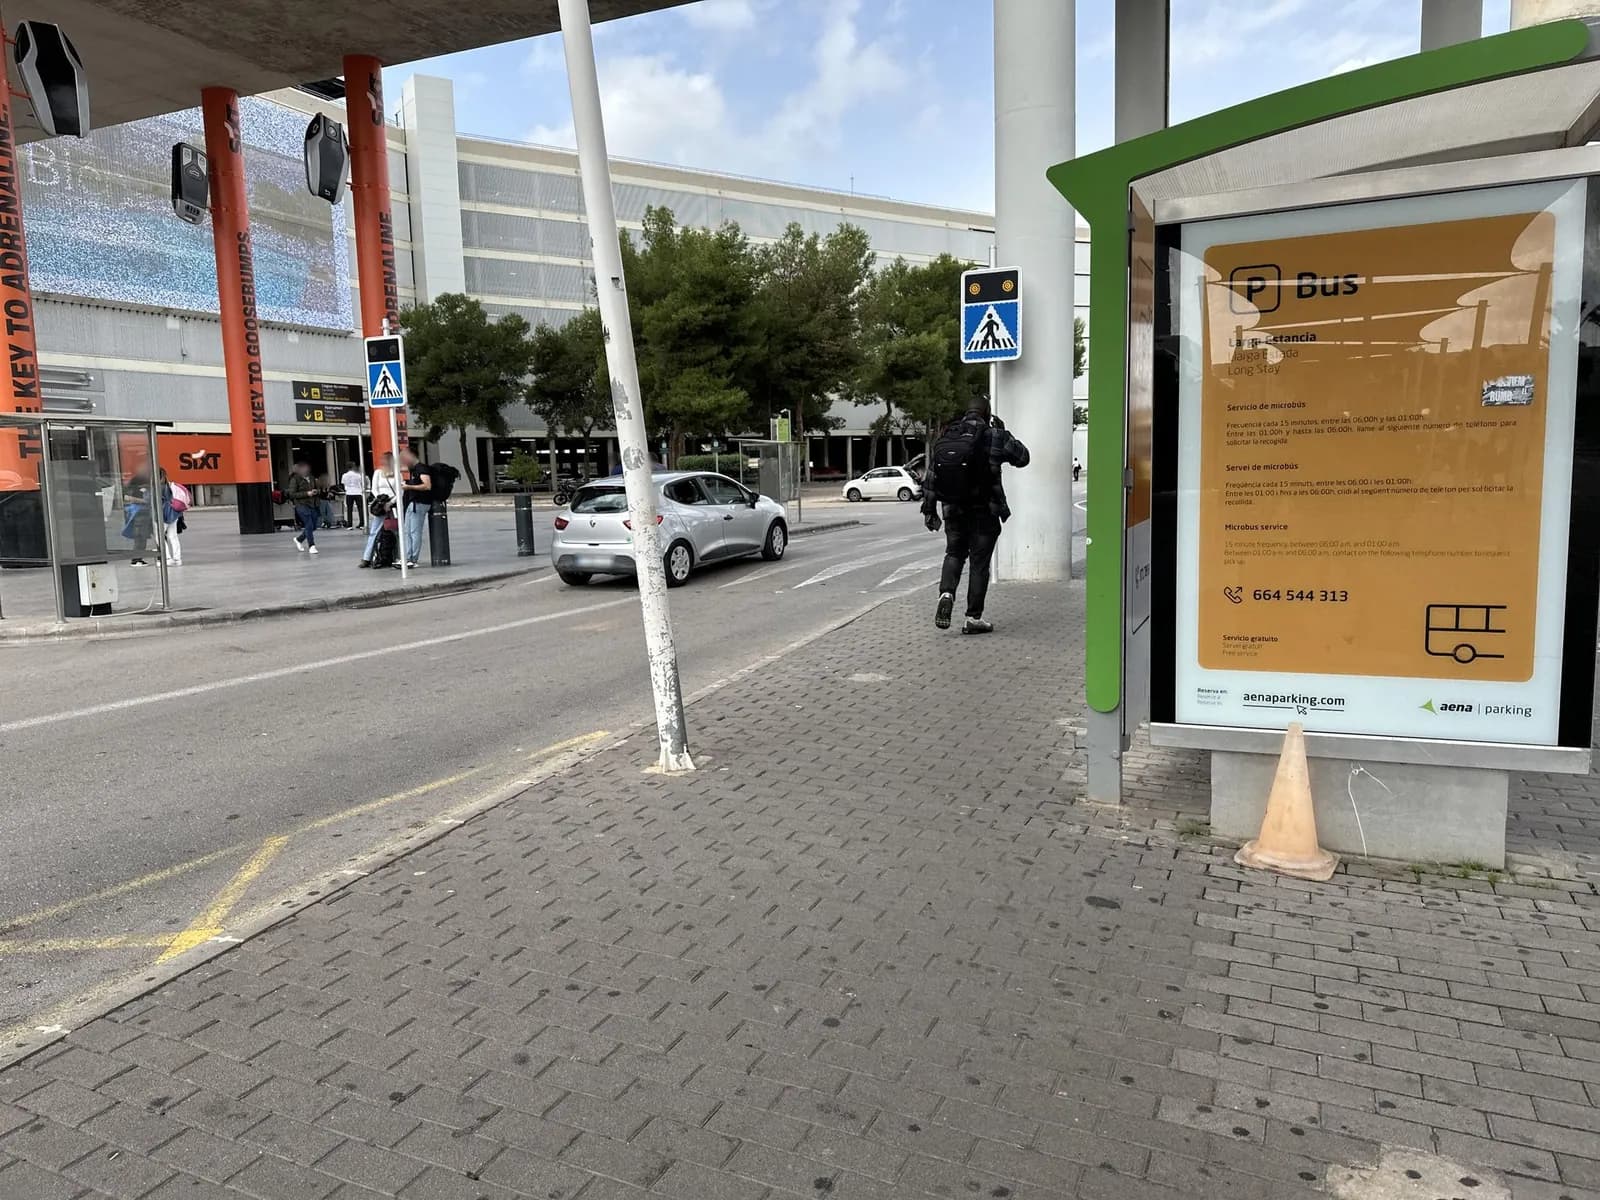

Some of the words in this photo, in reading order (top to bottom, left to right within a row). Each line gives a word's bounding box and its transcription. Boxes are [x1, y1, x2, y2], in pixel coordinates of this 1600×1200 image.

[1296, 272, 1359, 299] Bus
[4, 299, 31, 336] TO
[9, 344, 38, 398] KEY
[249, 362, 261, 384] TO
[1228, 365, 1253, 377] Long
[1257, 364, 1281, 376] Stay
[250, 390, 265, 423] KEY
[1227, 403, 1257, 411] Servicio
[1270, 401, 1306, 410] microbús
[1321, 418, 1339, 426] entre
[1500, 420, 1517, 429] para
[253, 426, 267, 461] THE
[179, 449, 221, 470] SIXT
[1226, 464, 1250, 472] Servei
[1252, 463, 1262, 471] de
[1263, 461, 1299, 470] microbús
[1262, 480, 1278, 488] cada
[1224, 523, 1259, 531] Microbus
[1260, 523, 1289, 531] service
[1253, 589, 1281, 601] 664
[1286, 590, 1314, 601] 544
[1320, 590, 1348, 602] 313
[1223, 634, 1249, 642] Servicio
[1250, 635, 1278, 644] gratuito
[1243, 692, 1345, 707] aenaparking.com
[1440, 703, 1473, 712] aena
[1485, 704, 1532, 718] parking
